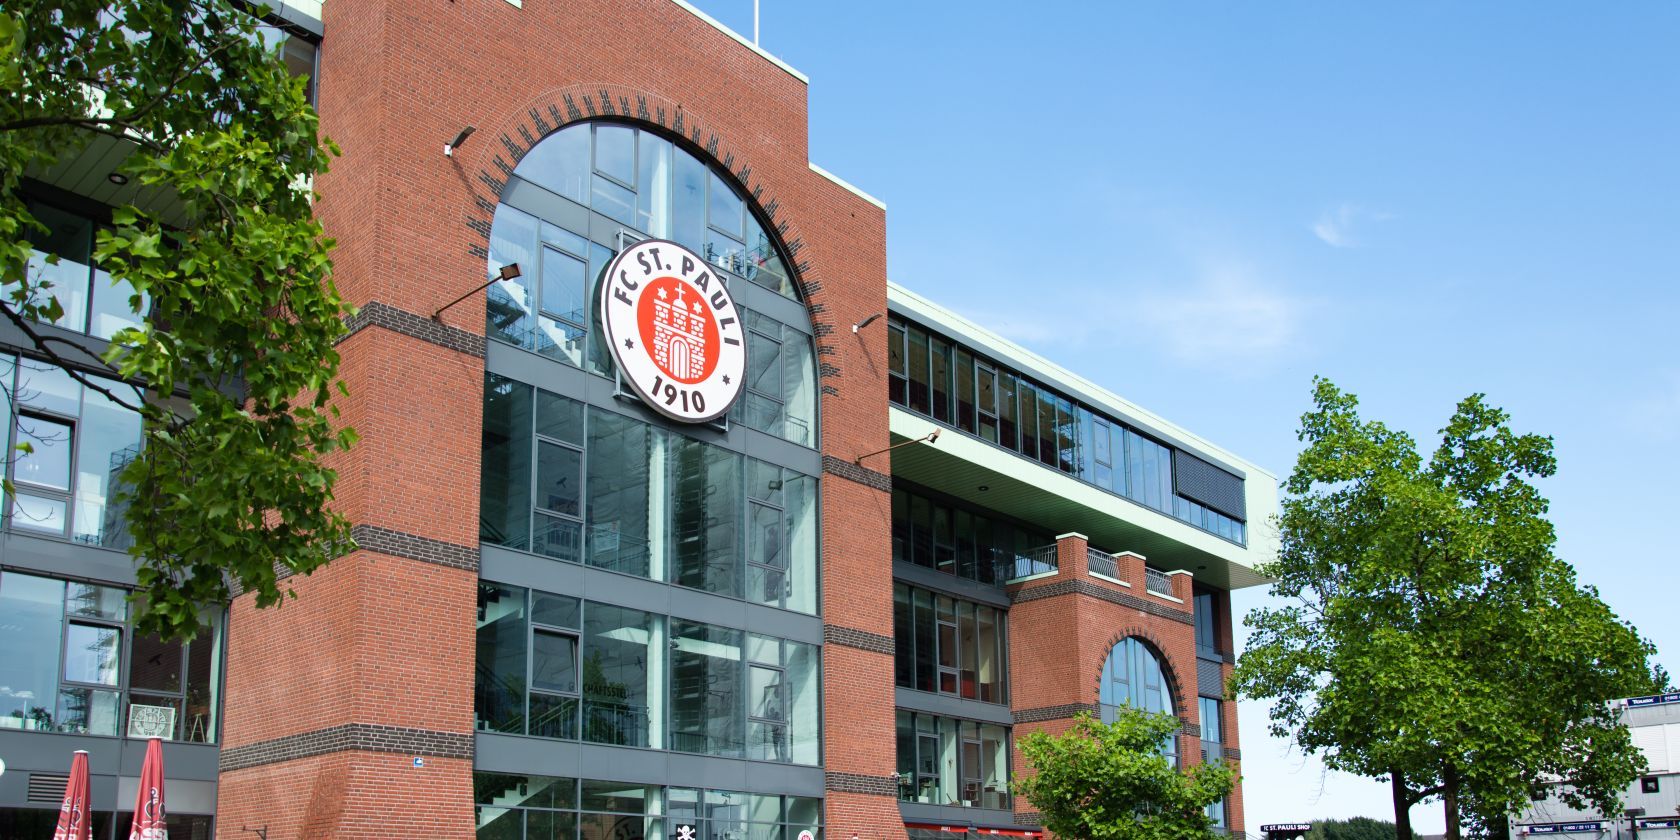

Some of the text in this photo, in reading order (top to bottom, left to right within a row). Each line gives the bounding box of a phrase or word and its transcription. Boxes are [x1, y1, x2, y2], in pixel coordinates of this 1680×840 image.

[614, 248, 740, 347] FC ST. PAULI
[651, 375, 705, 412] 1910
